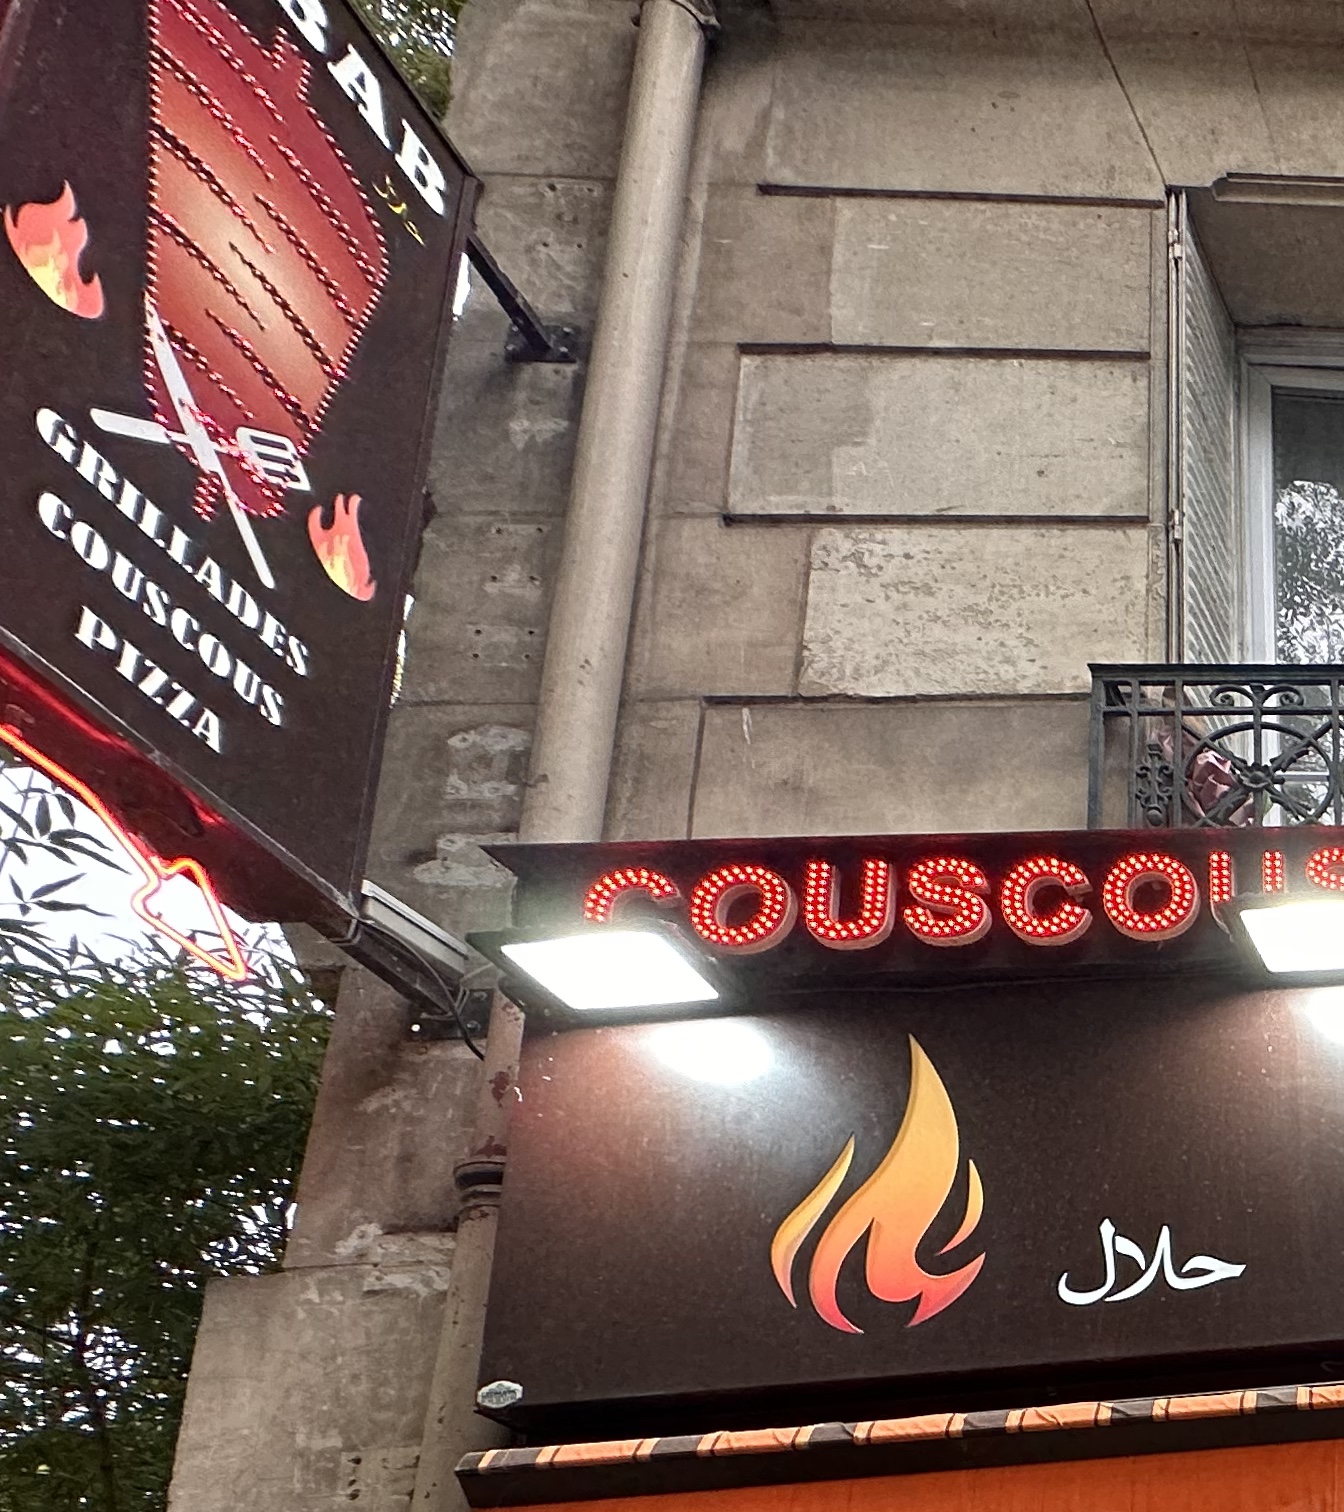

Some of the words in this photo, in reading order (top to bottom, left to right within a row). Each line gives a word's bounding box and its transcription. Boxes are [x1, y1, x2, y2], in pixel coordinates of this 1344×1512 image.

[36, 407, 310, 678] GRILLADES
[38, 492, 284, 728] COUSCOUS
[75, 605, 222, 754] PIZZA
[1057, 1217, 1248, 1306] حلال
